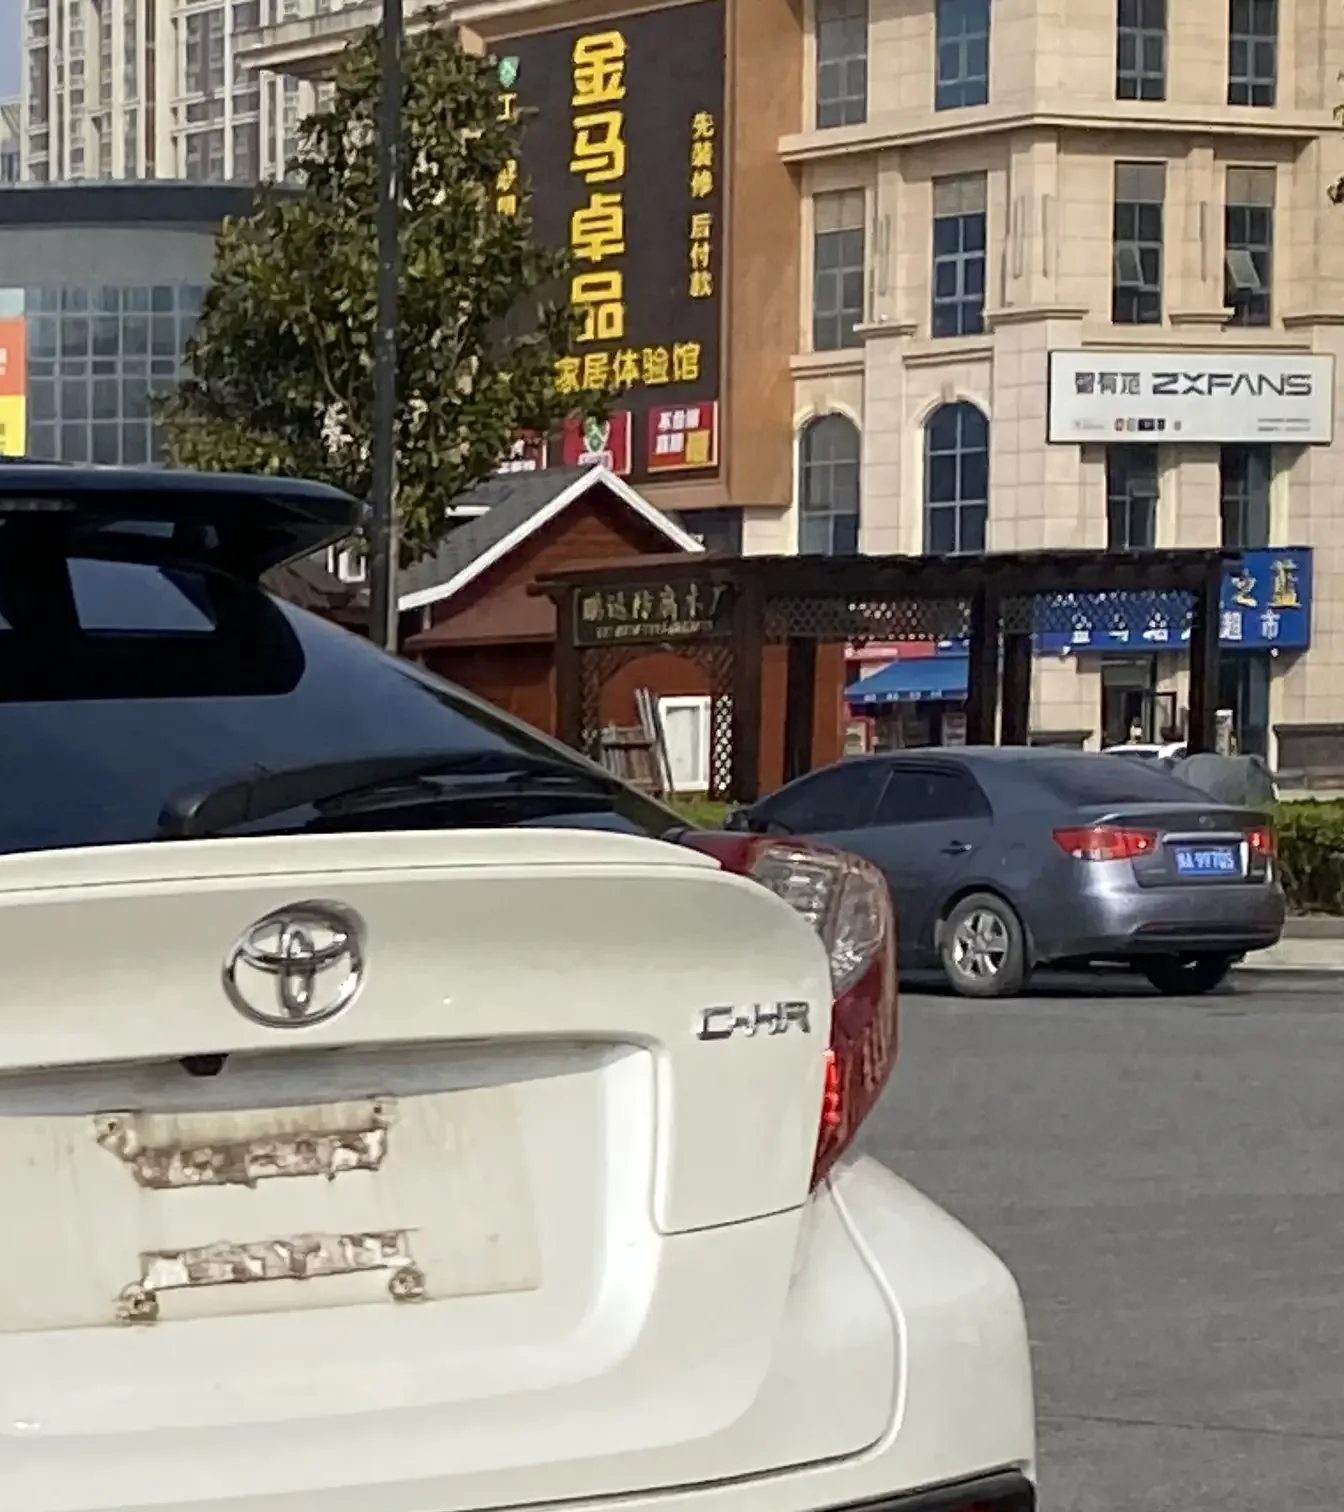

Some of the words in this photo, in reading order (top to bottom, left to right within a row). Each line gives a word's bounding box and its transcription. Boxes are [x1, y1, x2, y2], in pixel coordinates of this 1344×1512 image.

[569, 31, 628, 342] 金马卓品
[553, 341, 701, 394] 家居体验馆
[1151, 372, 1312, 397] ZXFANS
[693, 1000, 811, 1041] C-HR
